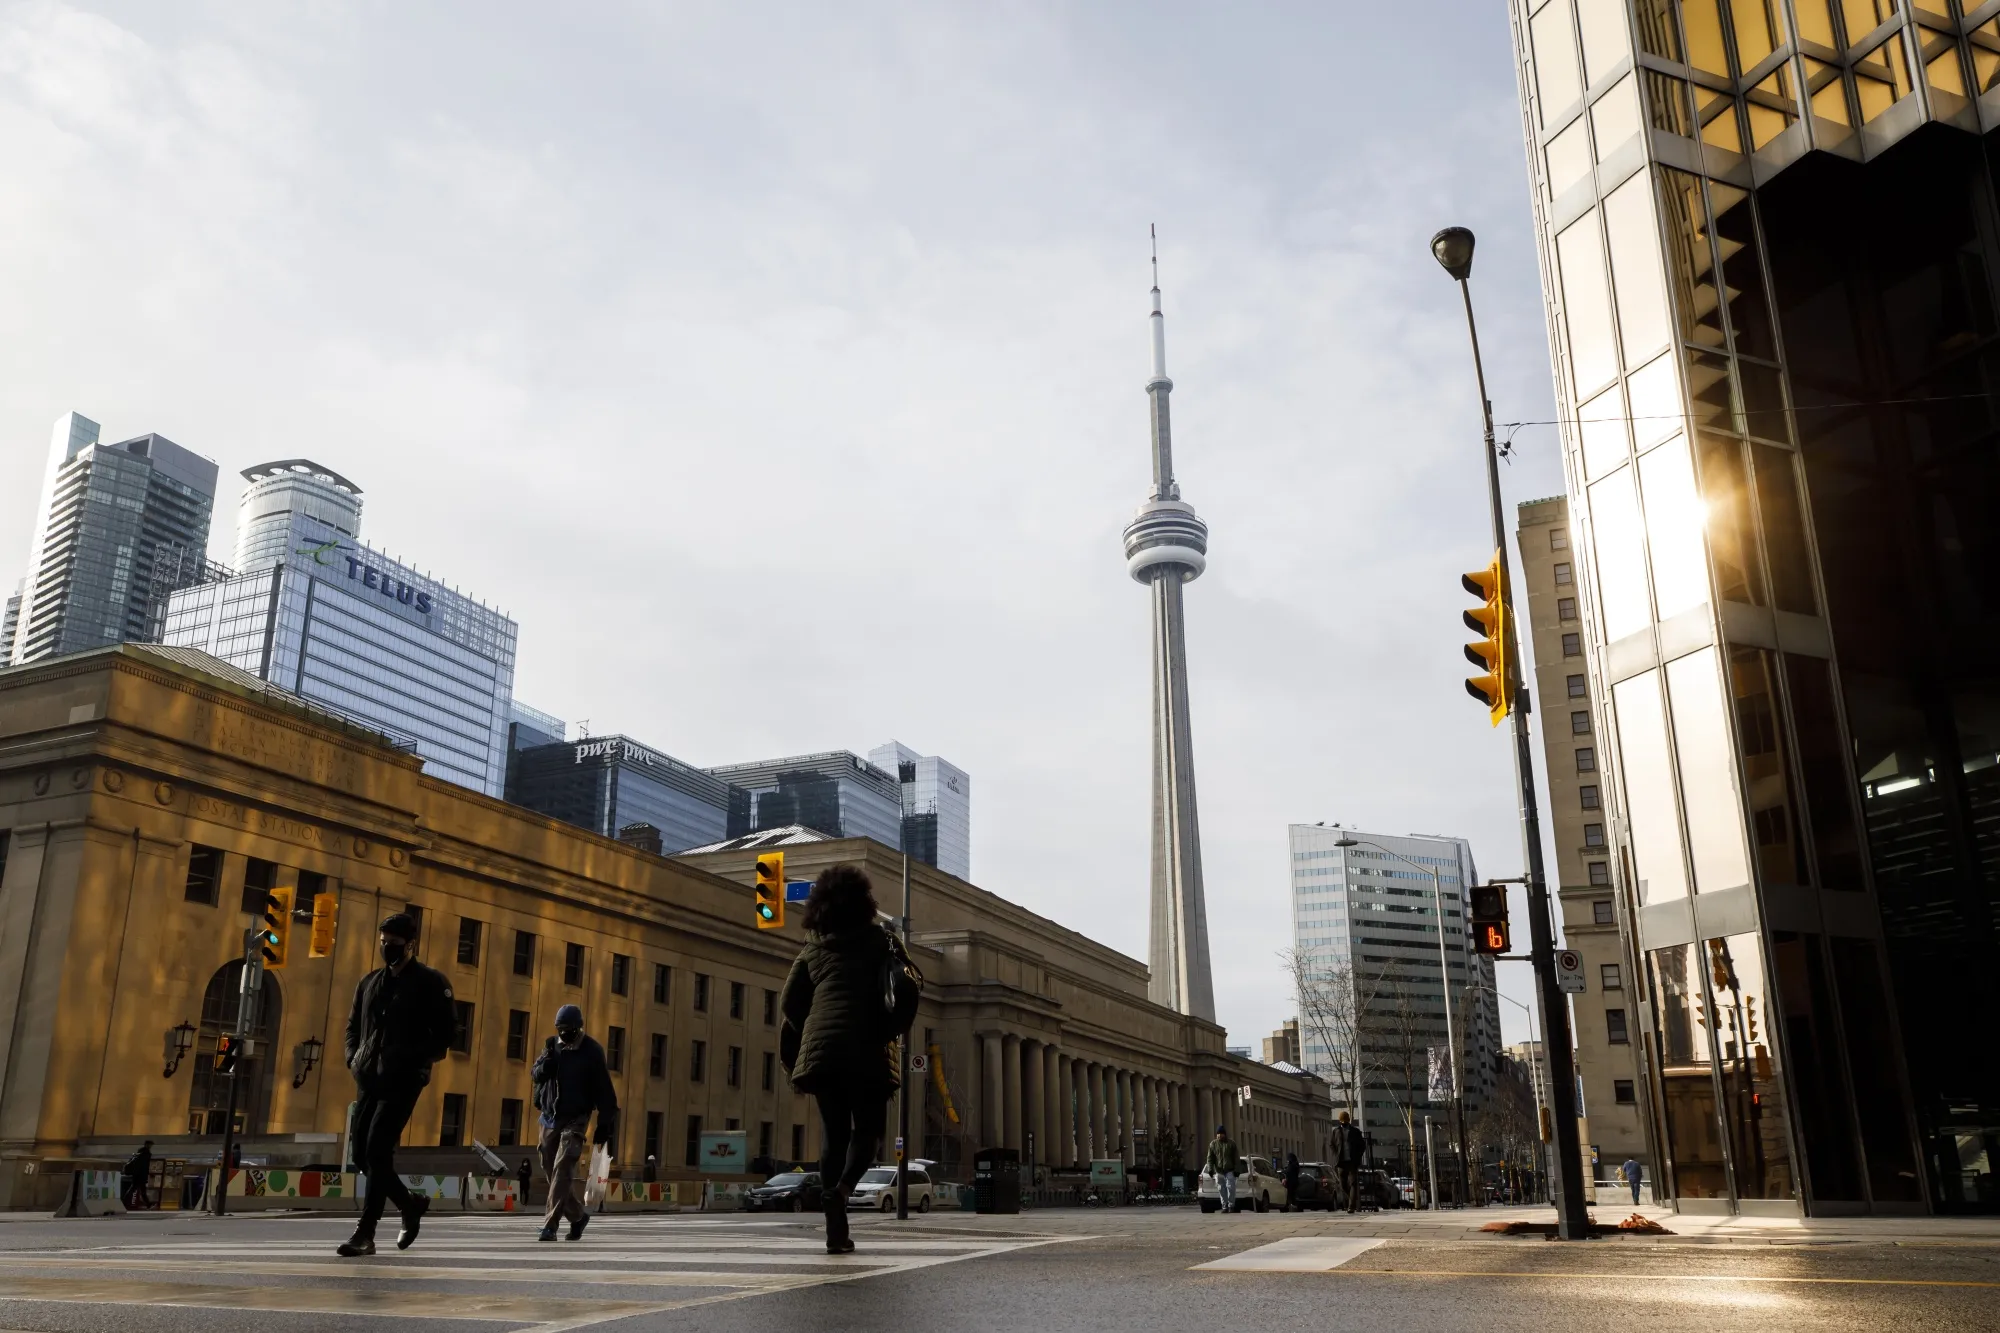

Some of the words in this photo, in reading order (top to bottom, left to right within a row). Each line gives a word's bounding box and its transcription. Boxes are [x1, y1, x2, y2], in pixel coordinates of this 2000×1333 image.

[346, 556, 432, 614] TELUS
[197, 704, 230, 723] HILL
[575, 739, 618, 764] pwc
[623, 741, 654, 766] pwc
[187, 795, 248, 823] POSTAL
[260, 814, 322, 842] STATION
[332, 835, 342, 850] A
